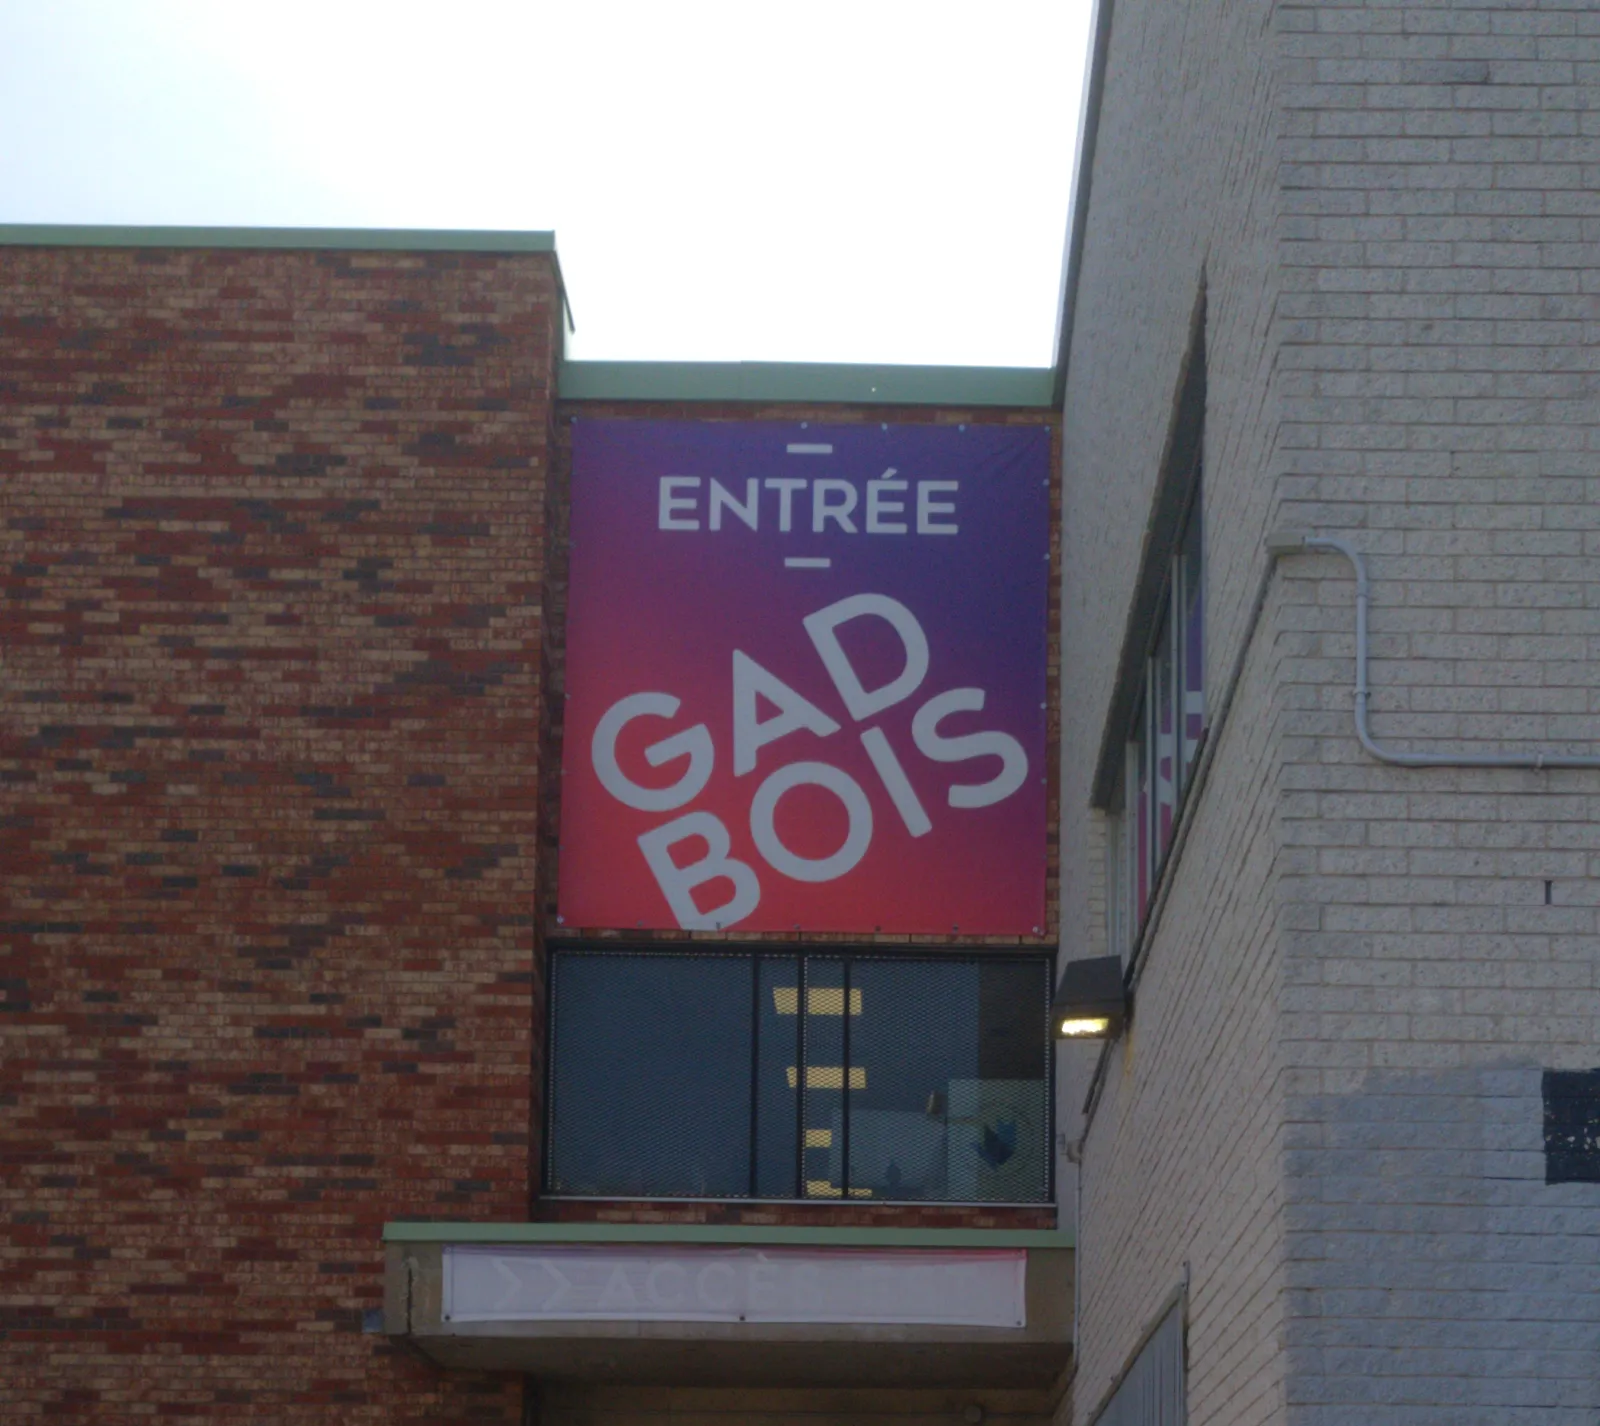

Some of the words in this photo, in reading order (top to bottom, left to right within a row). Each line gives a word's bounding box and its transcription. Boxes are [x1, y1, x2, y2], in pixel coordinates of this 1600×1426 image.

[658, 469, 959, 535] ENTRÉE
[592, 593, 930, 811] GAD
[637, 687, 1029, 931] BOIS
